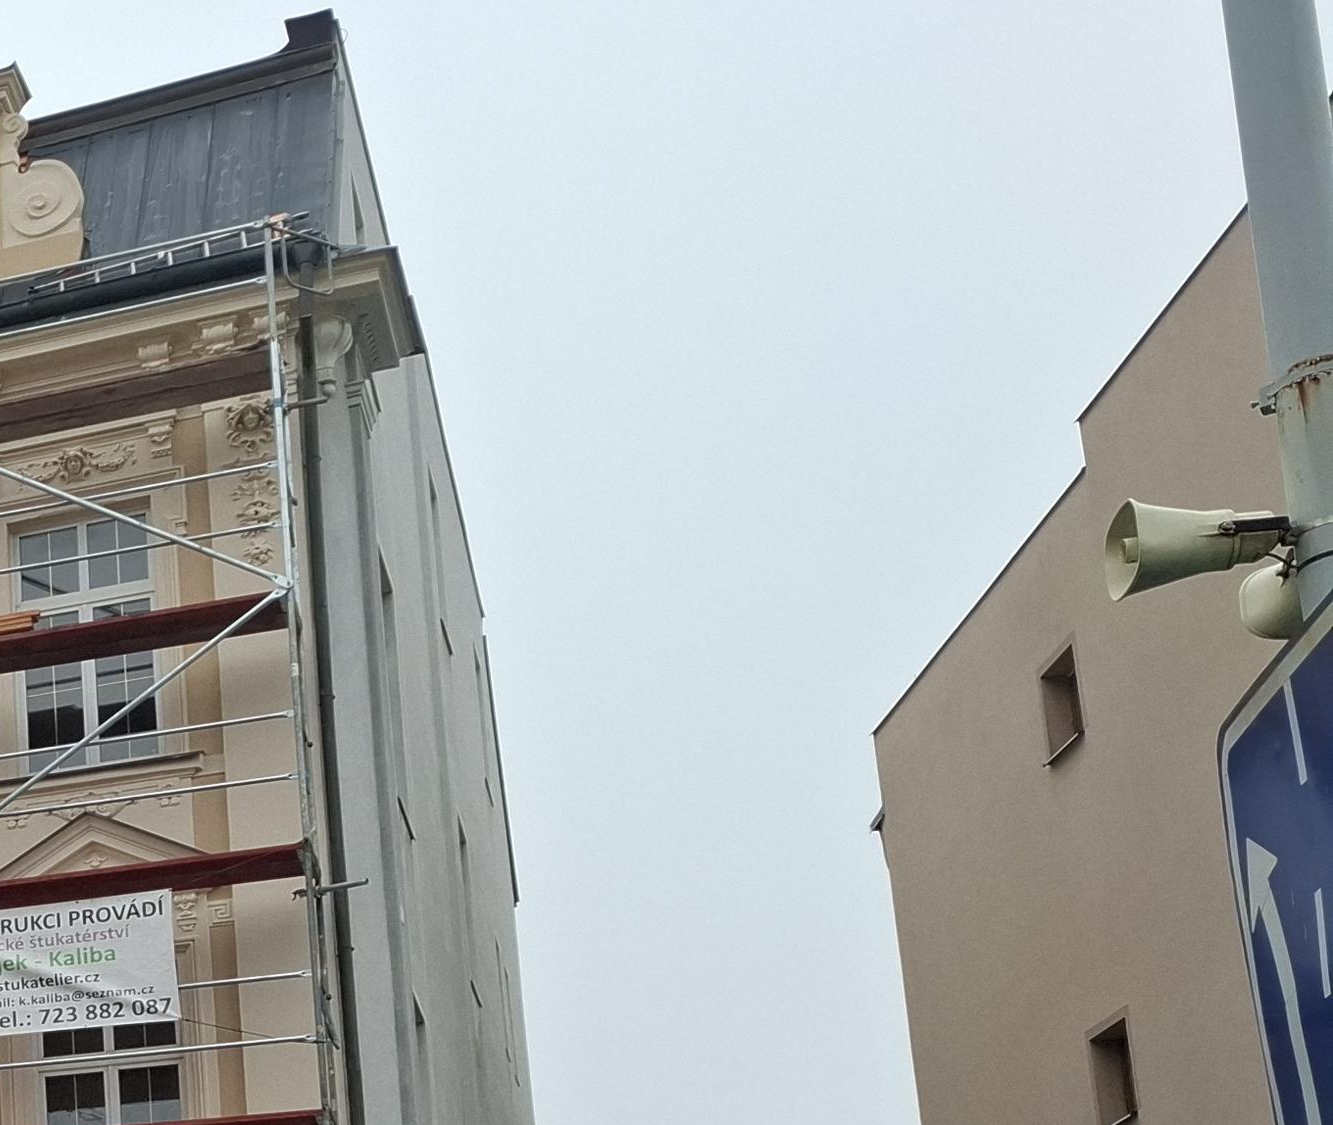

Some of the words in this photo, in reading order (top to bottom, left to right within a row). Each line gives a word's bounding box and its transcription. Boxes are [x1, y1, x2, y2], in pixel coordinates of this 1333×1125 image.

[69, 895, 164, 927] PROVÁDÍ
[29, 924, 130, 949] štukatérství
[49, 946, 116, 968] Kaliba
[19, 985, 155, 1007] k.kaliba@seznam.cz
[38, 1006, 78, 1025] 723
[85, 1001, 125, 1020] 882
[132, 997, 172, 1016] 087
